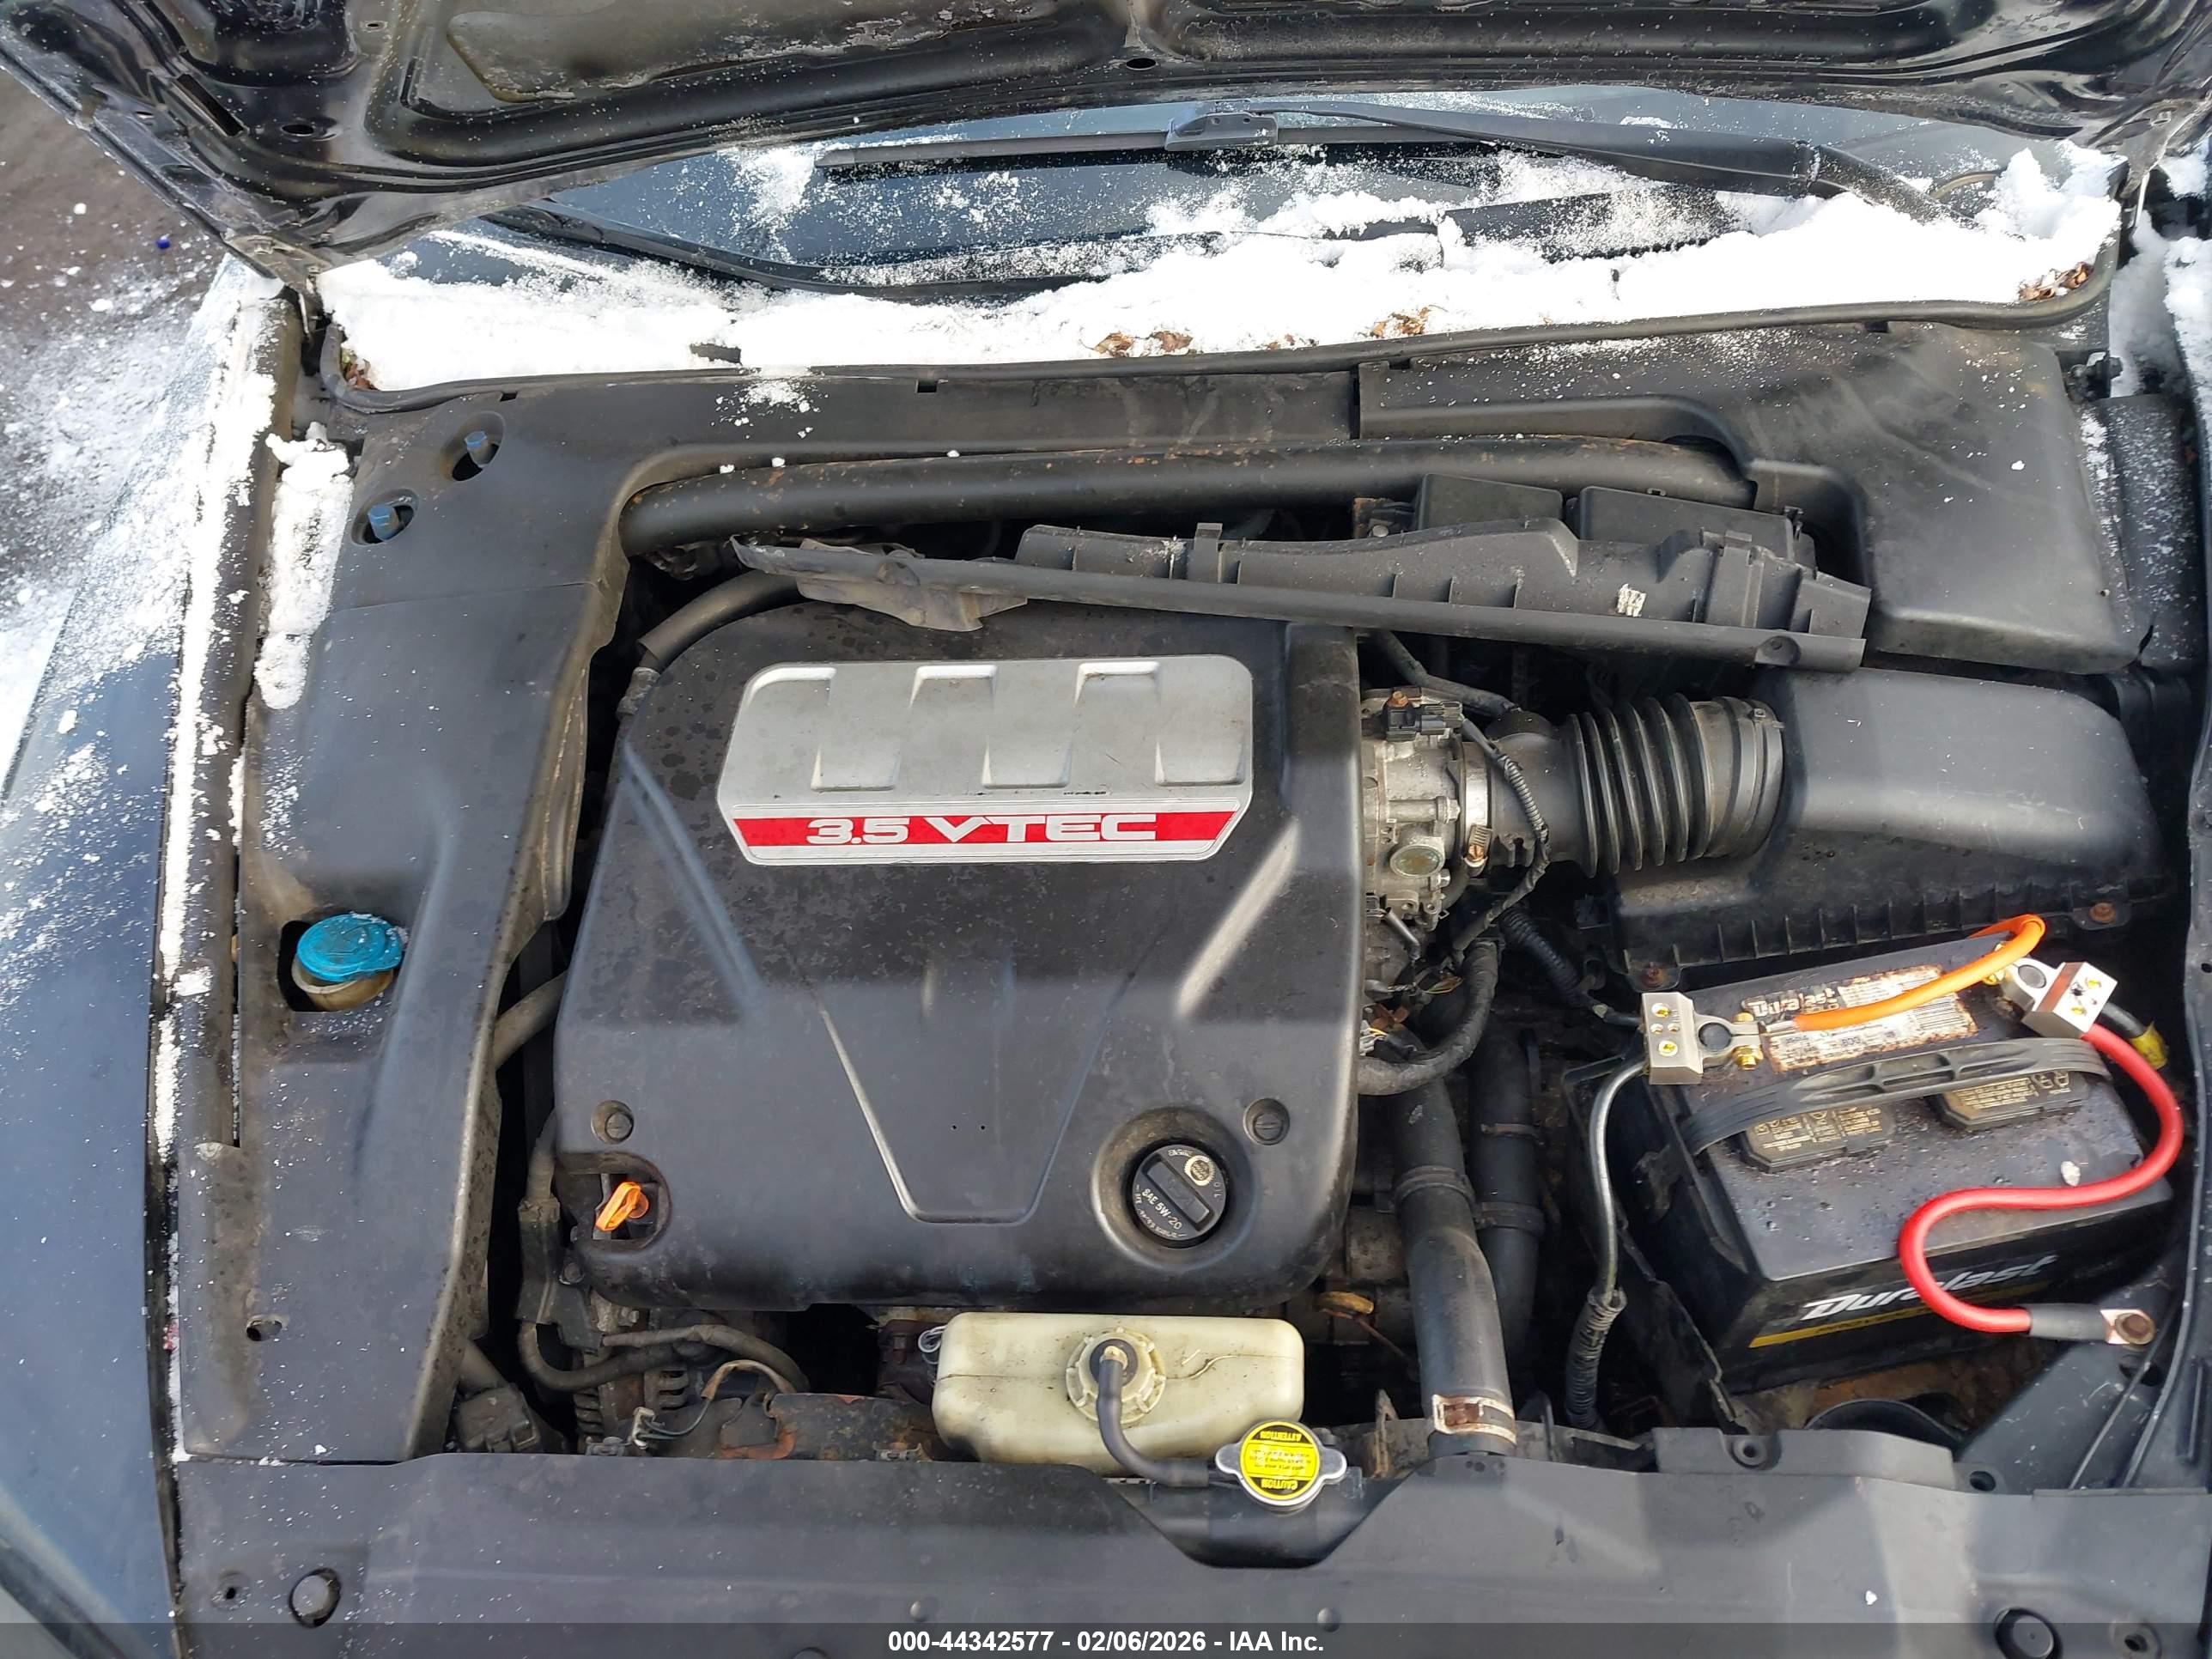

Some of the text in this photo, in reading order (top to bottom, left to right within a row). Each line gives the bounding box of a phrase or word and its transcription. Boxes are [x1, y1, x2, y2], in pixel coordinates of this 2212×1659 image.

[806, 814, 1157, 845] 3.5 VTEC
[1747, 988, 1836, 1018] Duralast
[1142, 1188, 1159, 1205] SAE
[1155, 1202, 1182, 1230] 5W-20
[1261, 1431, 1302, 1442] ATTENTION
[1261, 1479, 1298, 1490] CAUTION
